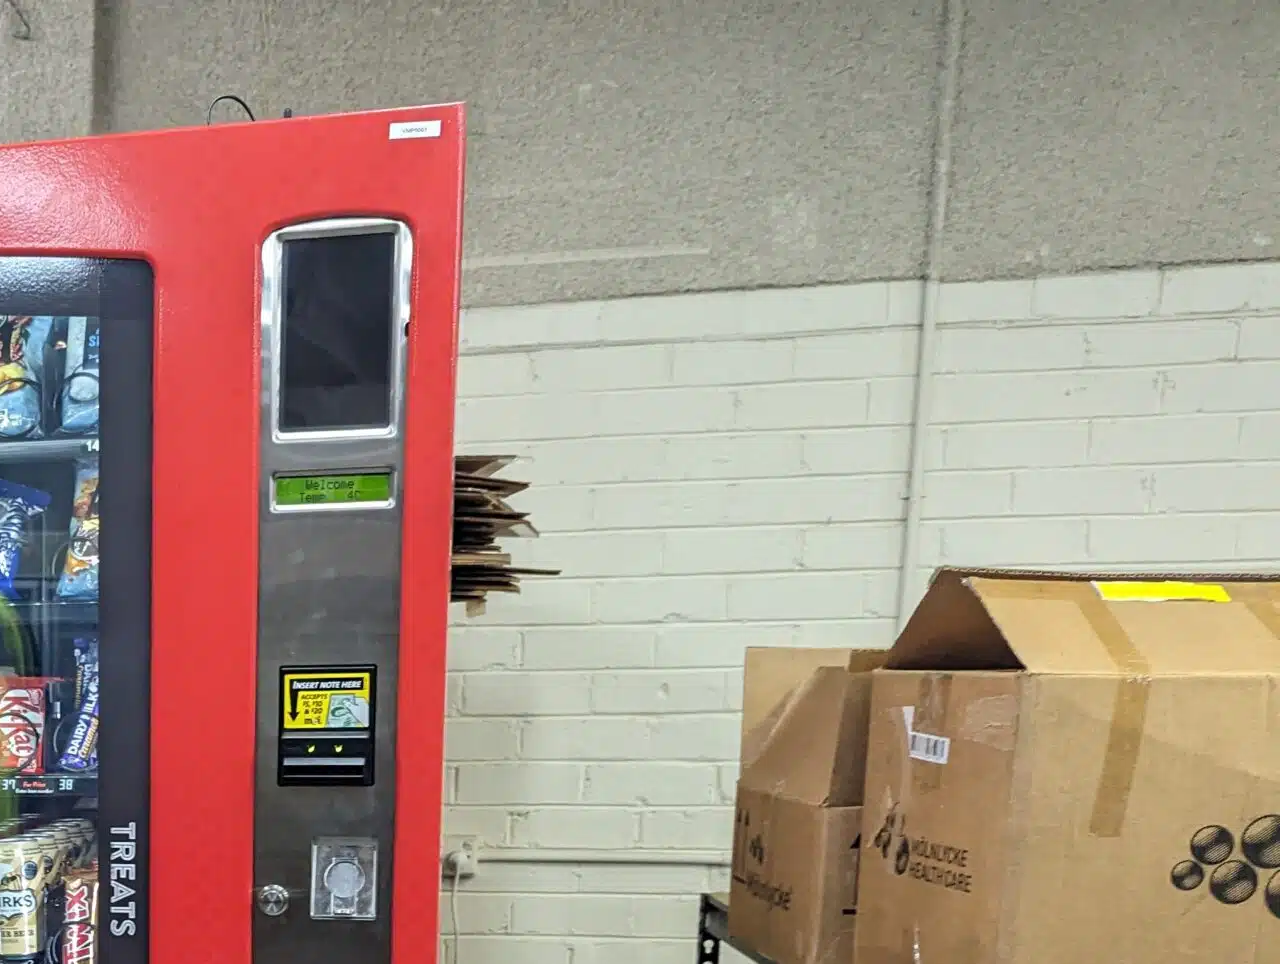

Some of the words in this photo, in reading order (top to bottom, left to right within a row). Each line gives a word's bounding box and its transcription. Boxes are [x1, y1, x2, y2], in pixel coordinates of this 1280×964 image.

[86, 440, 99, 452] 14
[305, 480, 354, 490] Welcome
[293, 681, 318, 689] INSERT
[320, 681, 340, 689] NOTE
[0, 697, 43, 753] KitKat
[68, 719, 87, 755] DAIRY
[2, 780, 16, 790] 37
[59, 780, 73, 790] 38
[911, 837, 969, 867] MÖLNLYCKE
[110, 822, 136, 937] TREATS
[944, 868, 972, 893] CARE
